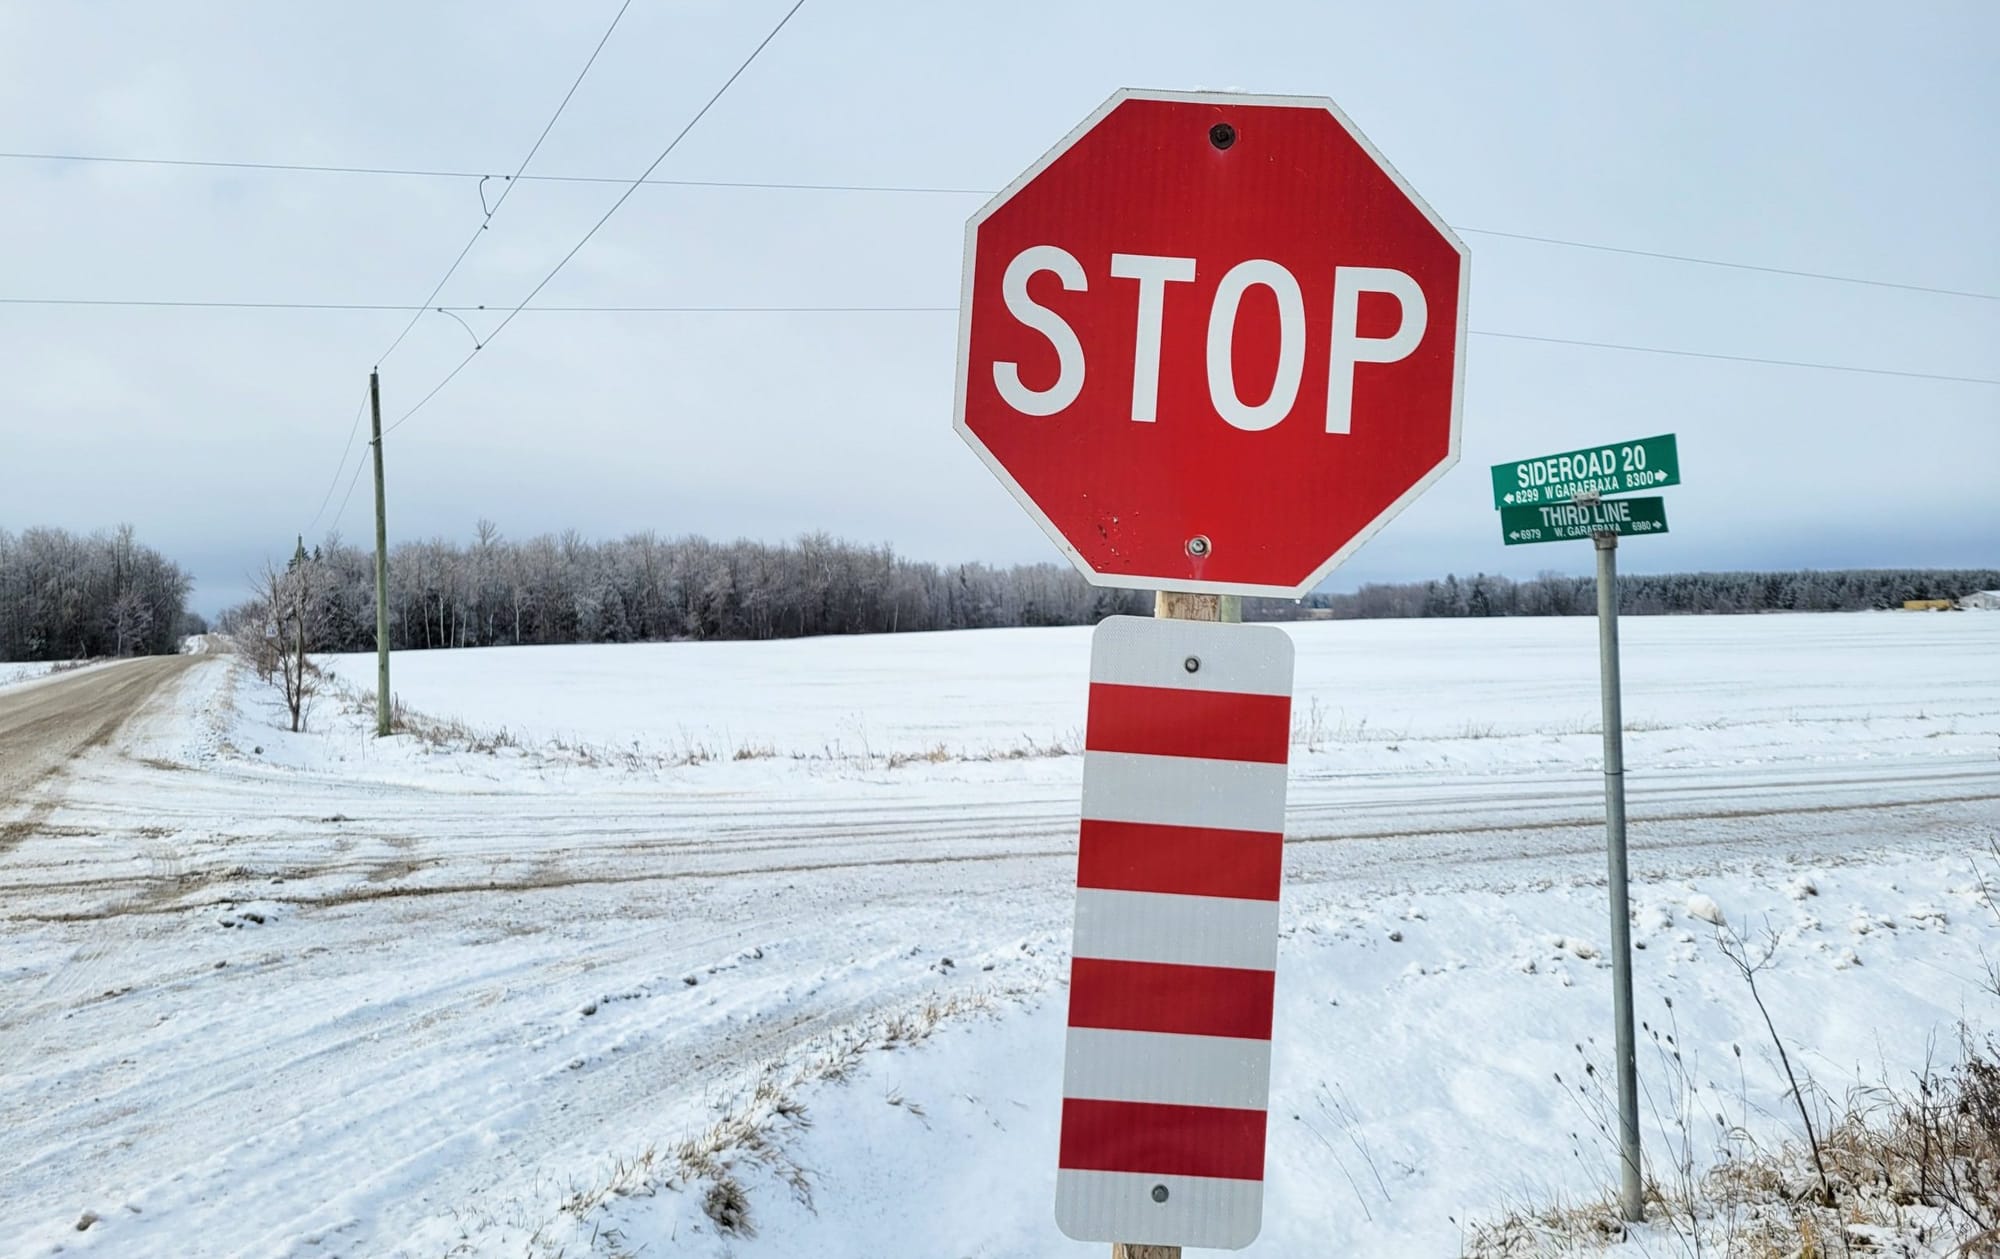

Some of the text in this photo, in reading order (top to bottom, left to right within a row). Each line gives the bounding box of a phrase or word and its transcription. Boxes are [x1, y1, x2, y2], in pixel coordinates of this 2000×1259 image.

[993, 245, 1428, 434] STOP
[1517, 445, 1646, 488] SIDEROAD 20
[1544, 486, 1554, 500] W
[1555, 475, 1620, 498] GARAFRAXA
[1626, 470, 1654, 488] 8300
[1539, 502, 1631, 527] THIRD LINE
[1520, 528, 1541, 540] 6979
[1554, 527, 1567, 538] W.
[1567, 522, 1622, 536] GARAFRAXA
